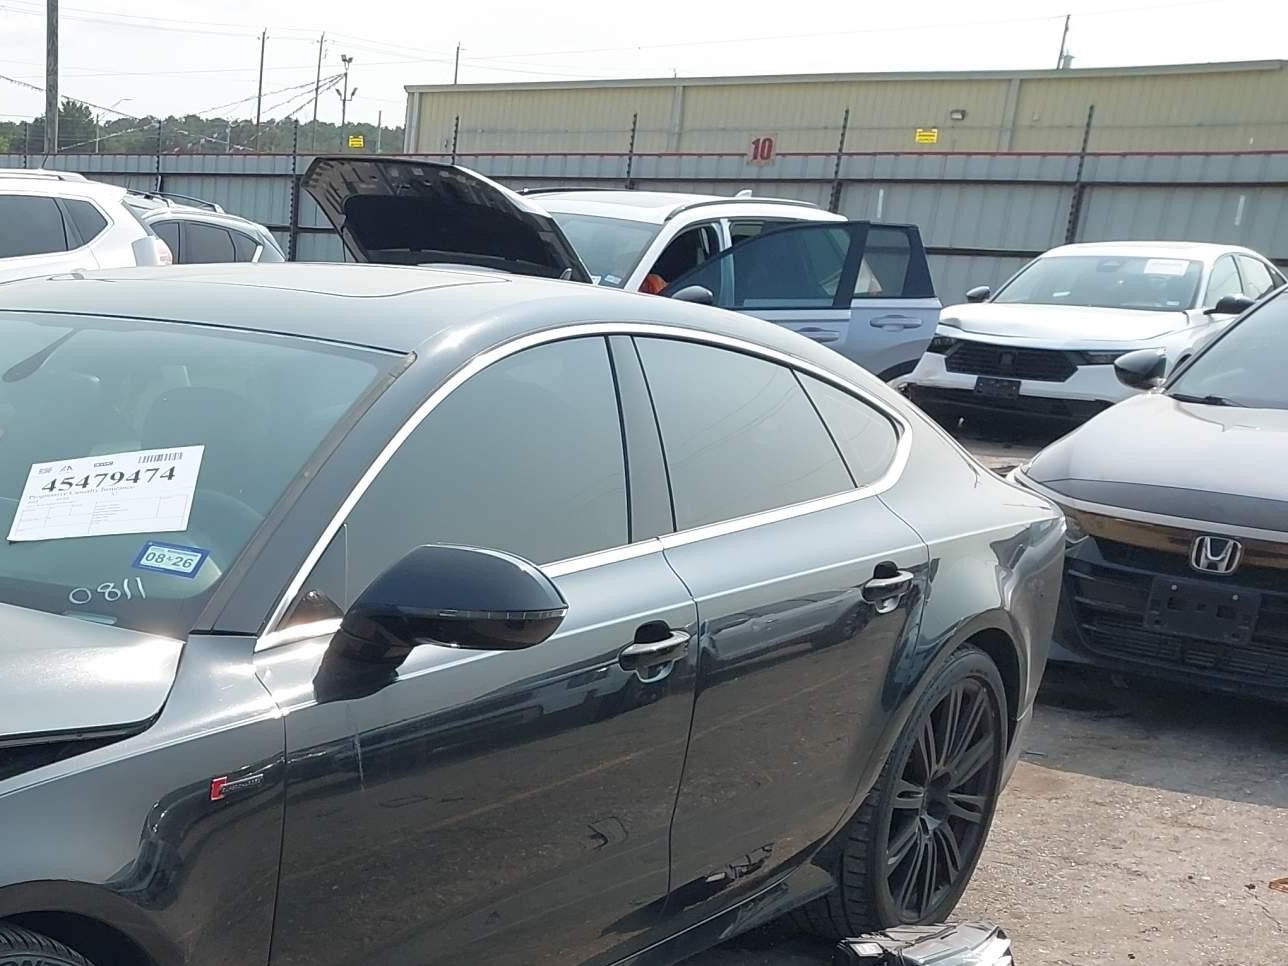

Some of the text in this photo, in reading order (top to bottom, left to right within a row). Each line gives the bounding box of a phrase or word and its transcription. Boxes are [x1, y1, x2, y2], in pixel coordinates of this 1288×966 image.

[751, 137, 774, 161] 10
[41, 466, 176, 492] 45479474
[145, 551, 166, 564] 08
[171, 556, 194, 568] 26
[68, 577, 146, 605] 0811
